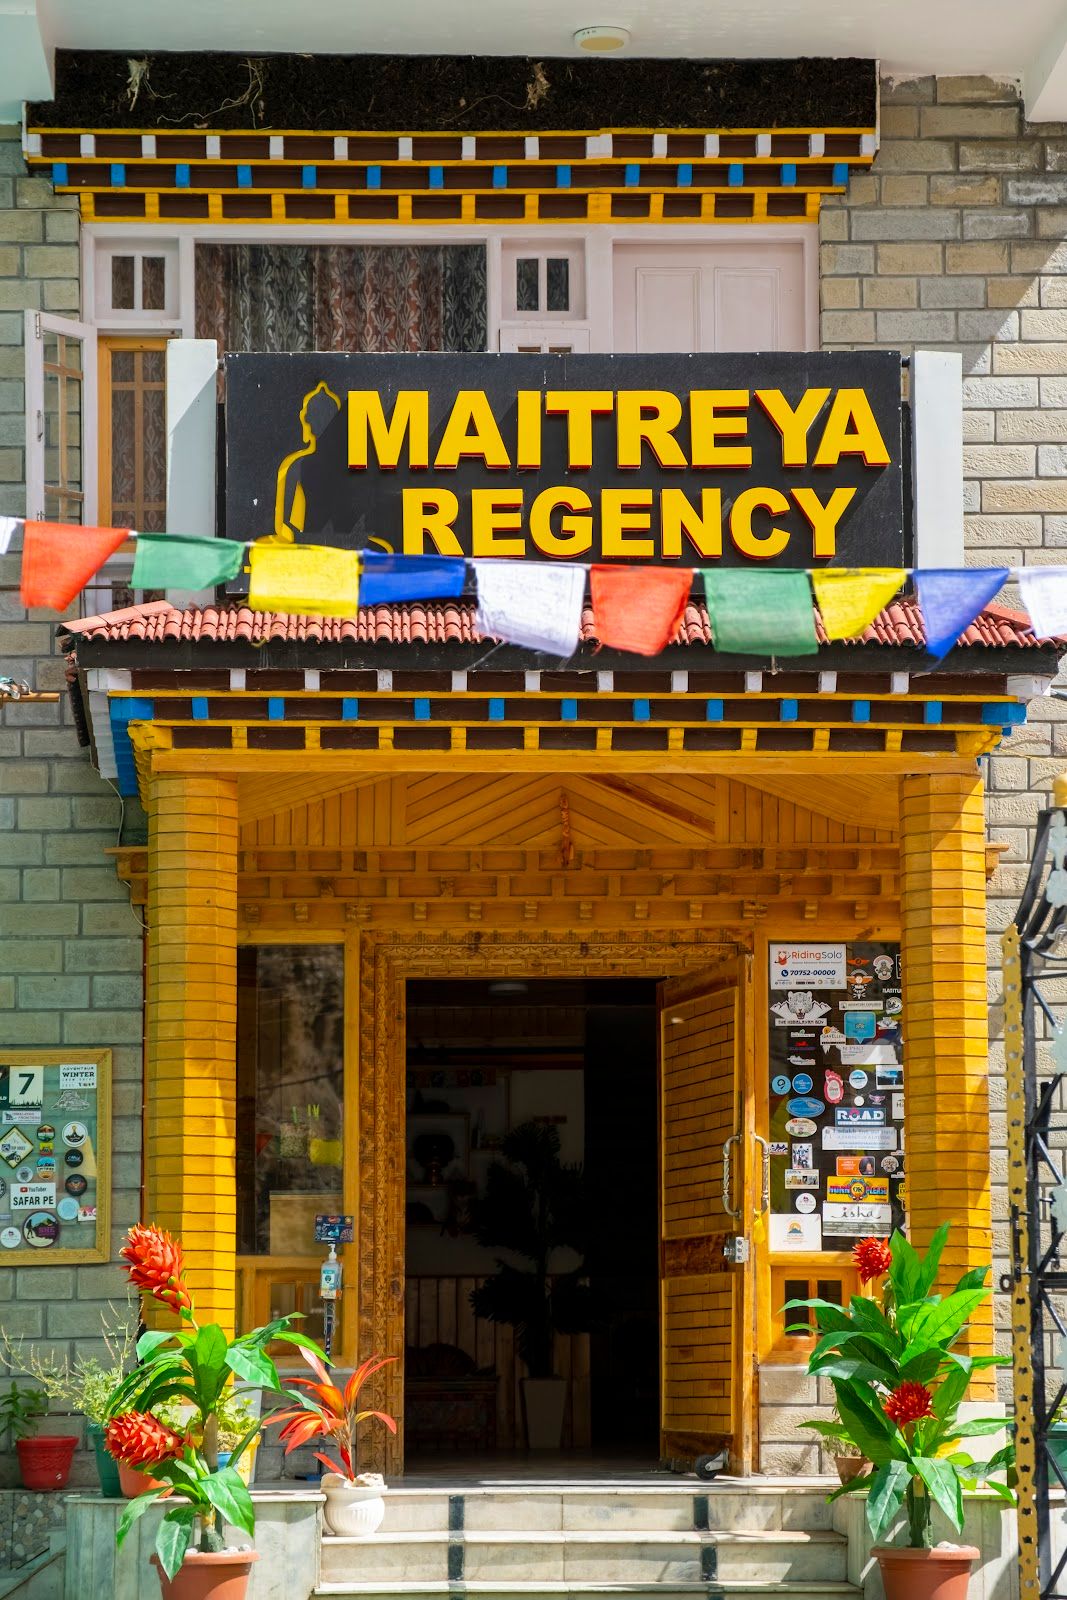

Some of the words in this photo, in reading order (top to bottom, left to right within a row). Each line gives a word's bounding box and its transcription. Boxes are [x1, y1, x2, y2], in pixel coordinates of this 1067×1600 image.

[347, 387, 892, 470] MAITREYA
[401, 487, 857, 561] REGENCY
[791, 951, 842, 961] RidingSolo
[19, 1073, 34, 1095] 7
[13, 1196, 41, 1206] SAFAR
[43, 1196, 54, 1205] PE
[834, 1206, 880, 1219] isha
